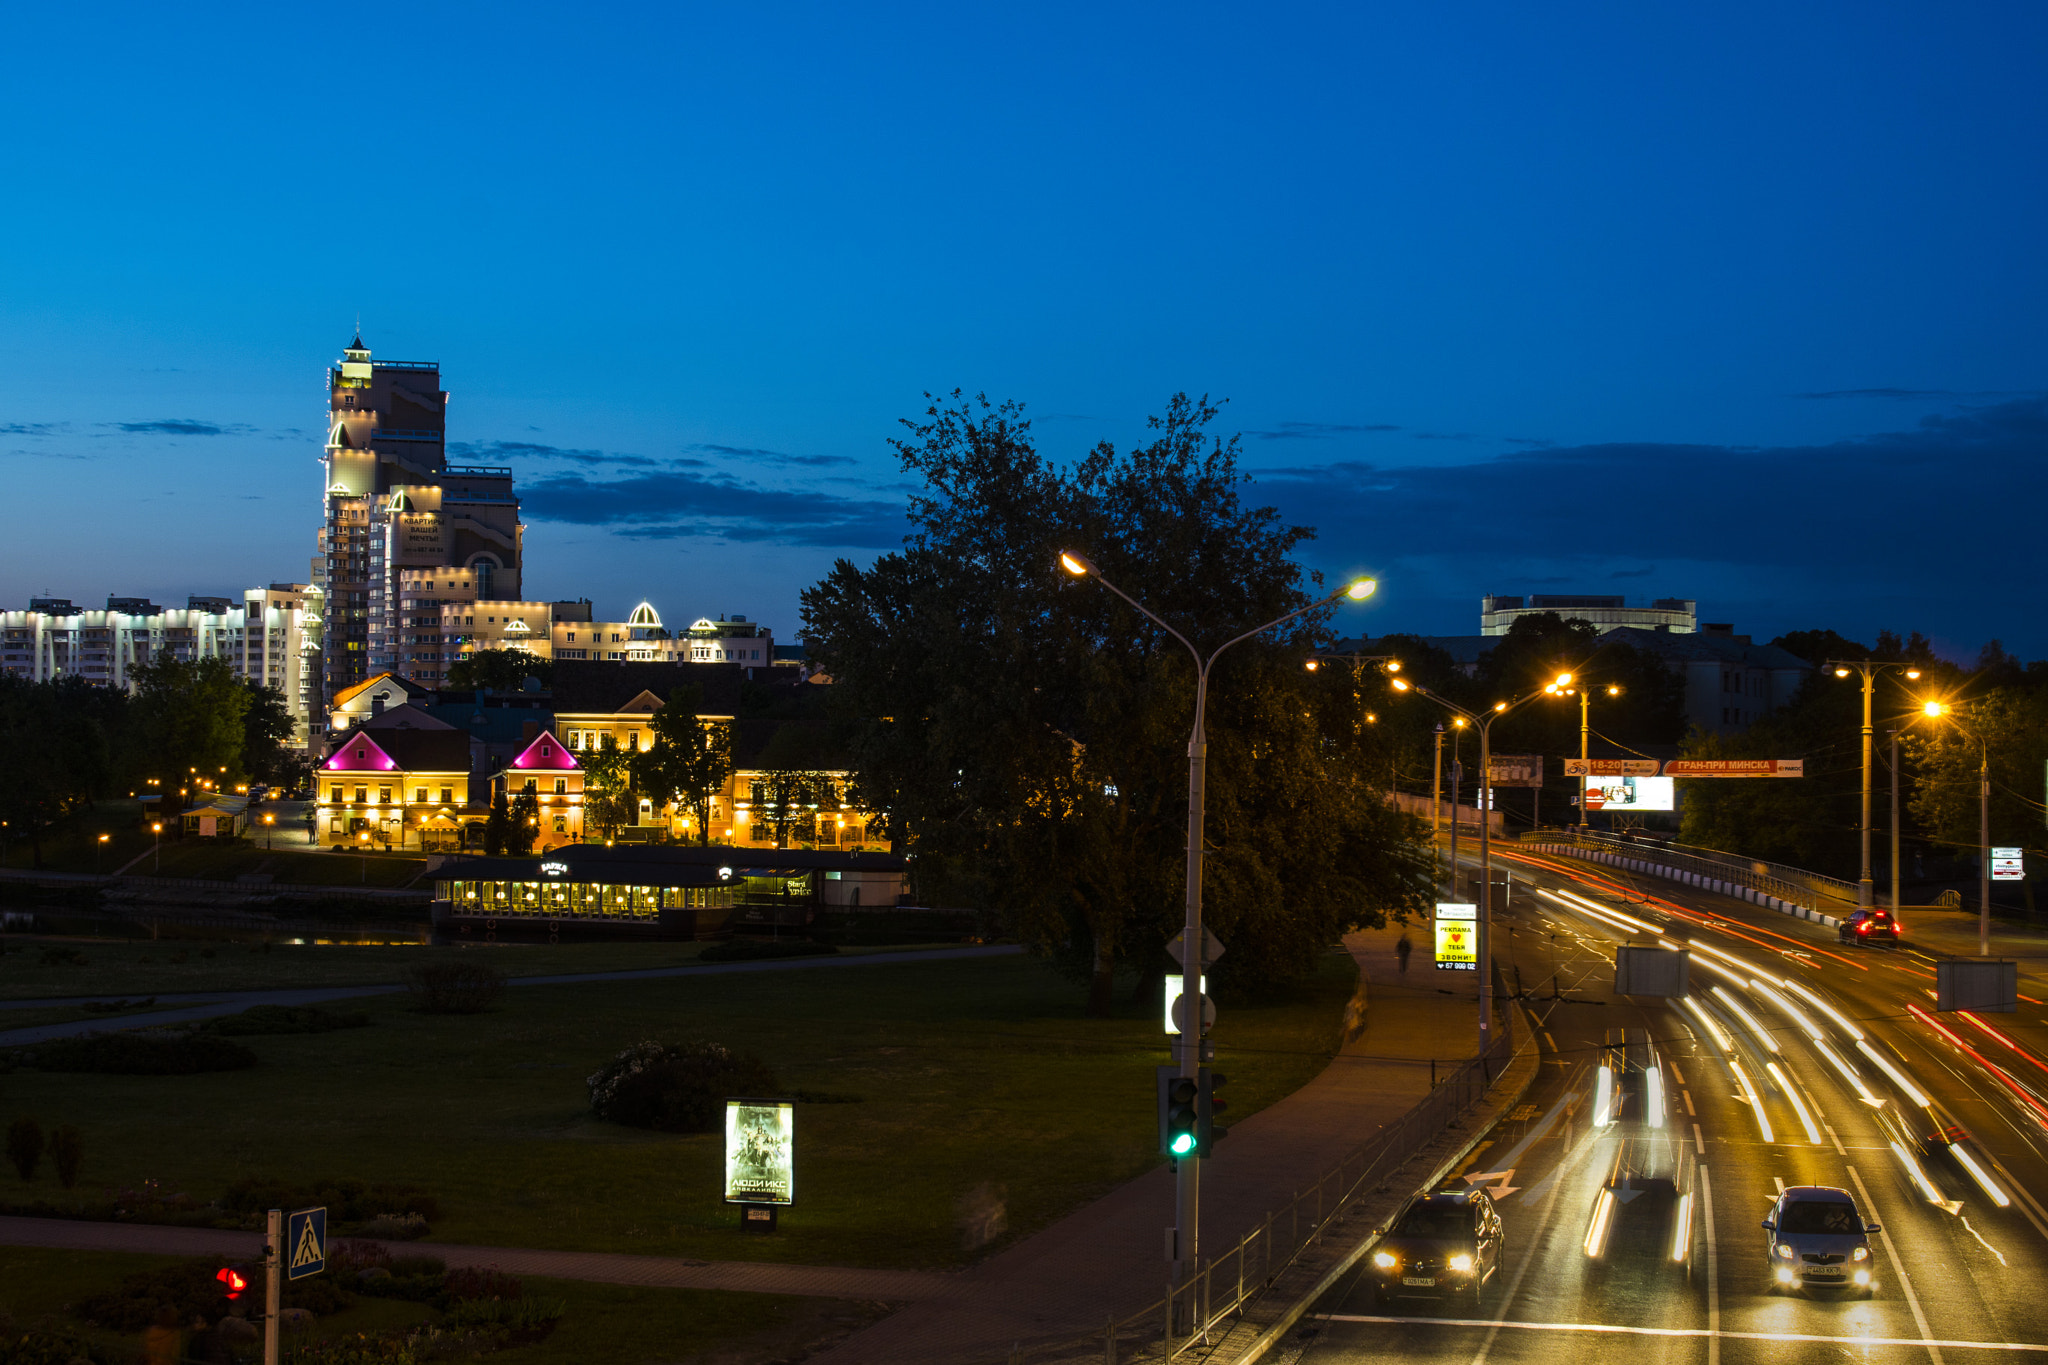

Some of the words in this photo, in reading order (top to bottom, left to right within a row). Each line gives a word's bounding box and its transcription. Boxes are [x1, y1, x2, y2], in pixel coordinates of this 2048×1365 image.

[1591, 760, 1621, 769] 18-20
[1678, 760, 1726, 770] ГРАН-ПРИ
[1728, 760, 1770, 770] МИНСКА
[732, 1179, 764, 1187] ЛЮДИ
[765, 1180, 786, 1188] ИКС
